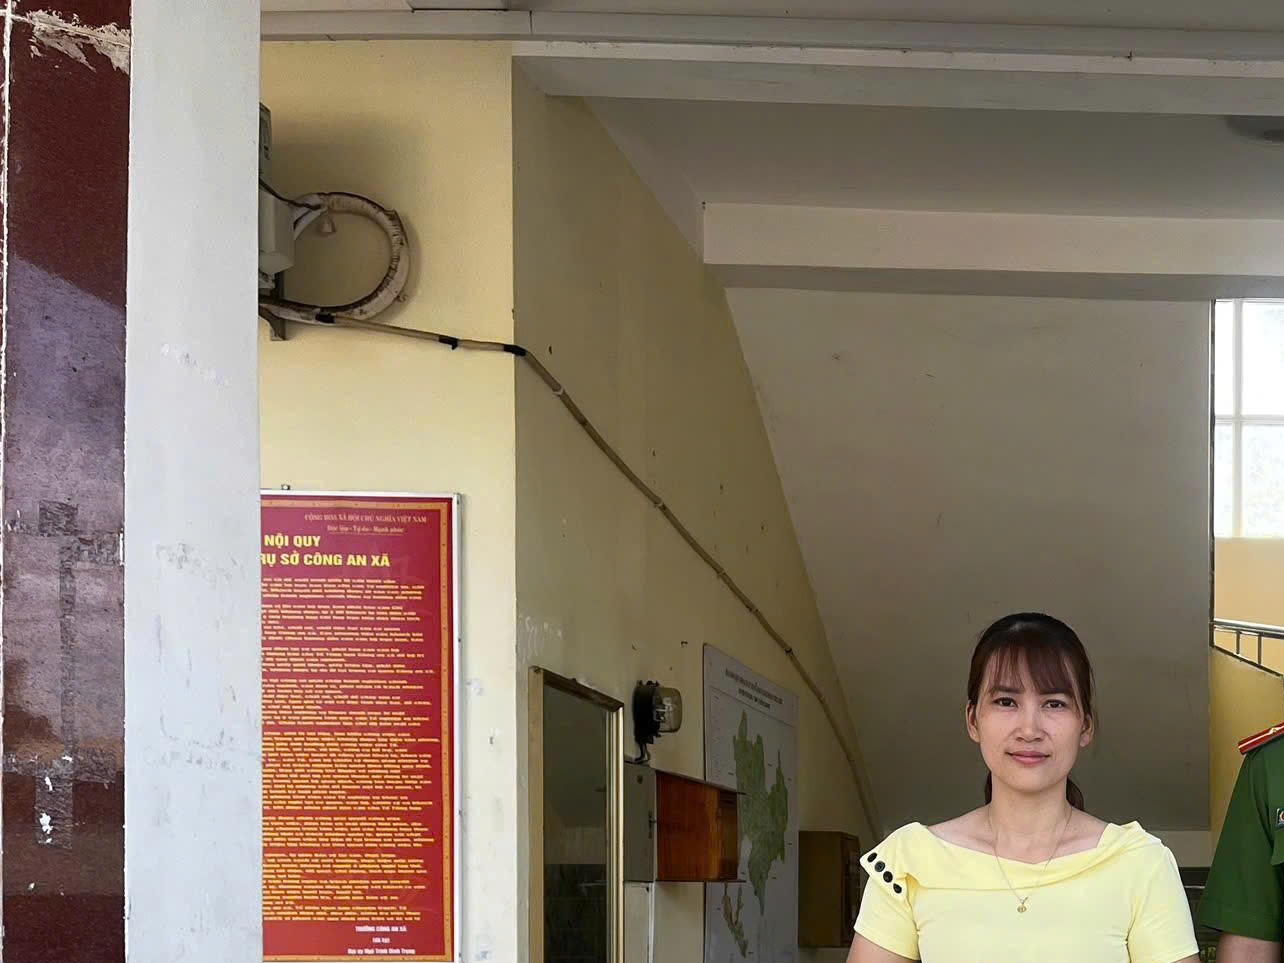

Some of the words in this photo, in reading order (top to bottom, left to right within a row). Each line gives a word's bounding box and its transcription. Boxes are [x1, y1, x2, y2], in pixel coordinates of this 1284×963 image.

[264, 533, 289, 549] NỘI
[293, 535, 320, 548] QUY
[280, 551, 299, 566] SỞ
[304, 552, 342, 566] CÔNG
[347, 555, 367, 567] AN
[371, 553, 390, 567] XÃ
